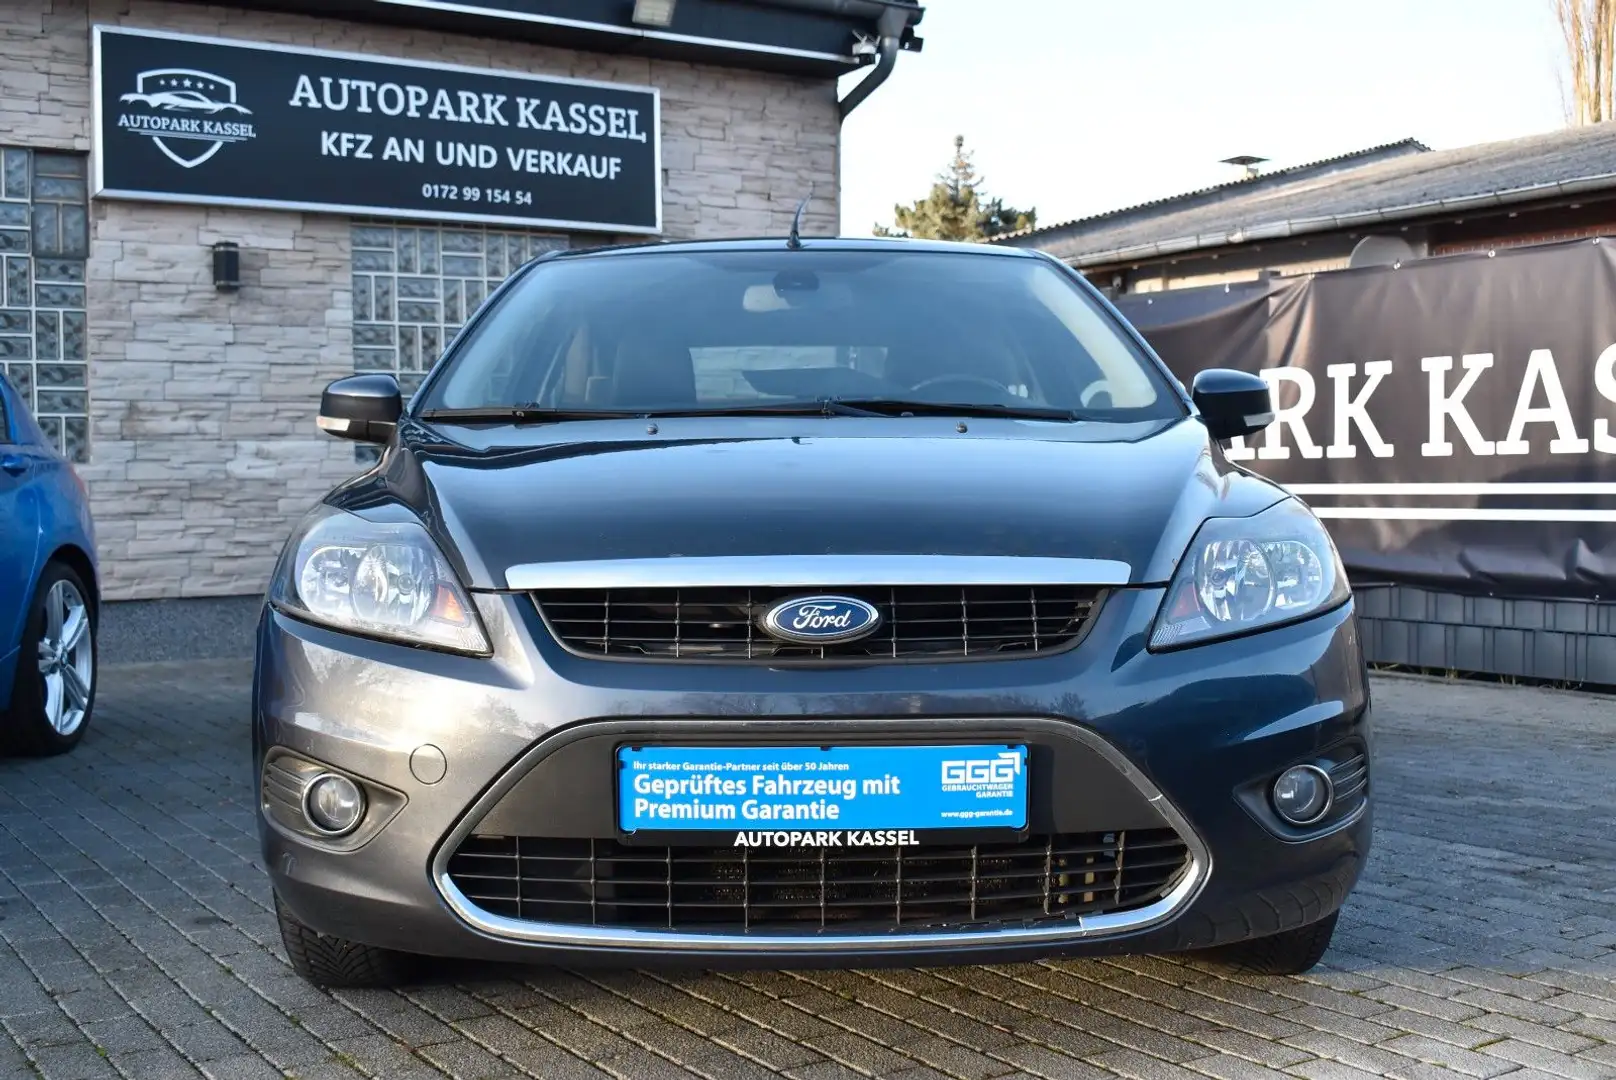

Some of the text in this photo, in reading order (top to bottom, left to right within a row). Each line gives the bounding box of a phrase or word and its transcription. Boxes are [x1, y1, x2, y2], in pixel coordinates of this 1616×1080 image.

[289, 74, 646, 143] AUTOPARK KASSEL
[118, 114, 256, 138] AUTOPARK KASSEL
[321, 130, 621, 180] KFZ AN UND VERKAUF
[422, 183, 532, 205] 0172 99 154 54
[1223, 360, 1395, 461] RK
[792, 604, 851, 629] Ford
[633, 761, 849, 771] Ihr starker Garantie-Partner seit über 50 Jahren
[941, 759, 1014, 784] GGG
[634, 773, 901, 800] Geprüftes Fahrzeug mit
[941, 783, 1014, 792] GEBRAUCHTWAGEN
[975, 790, 1014, 798] GARANTIE
[634, 798, 840, 820] Premium Garantie
[941, 809, 1014, 819] www.ggg-garantie.de
[733, 830, 920, 847] AUTOPARK KASSEL
